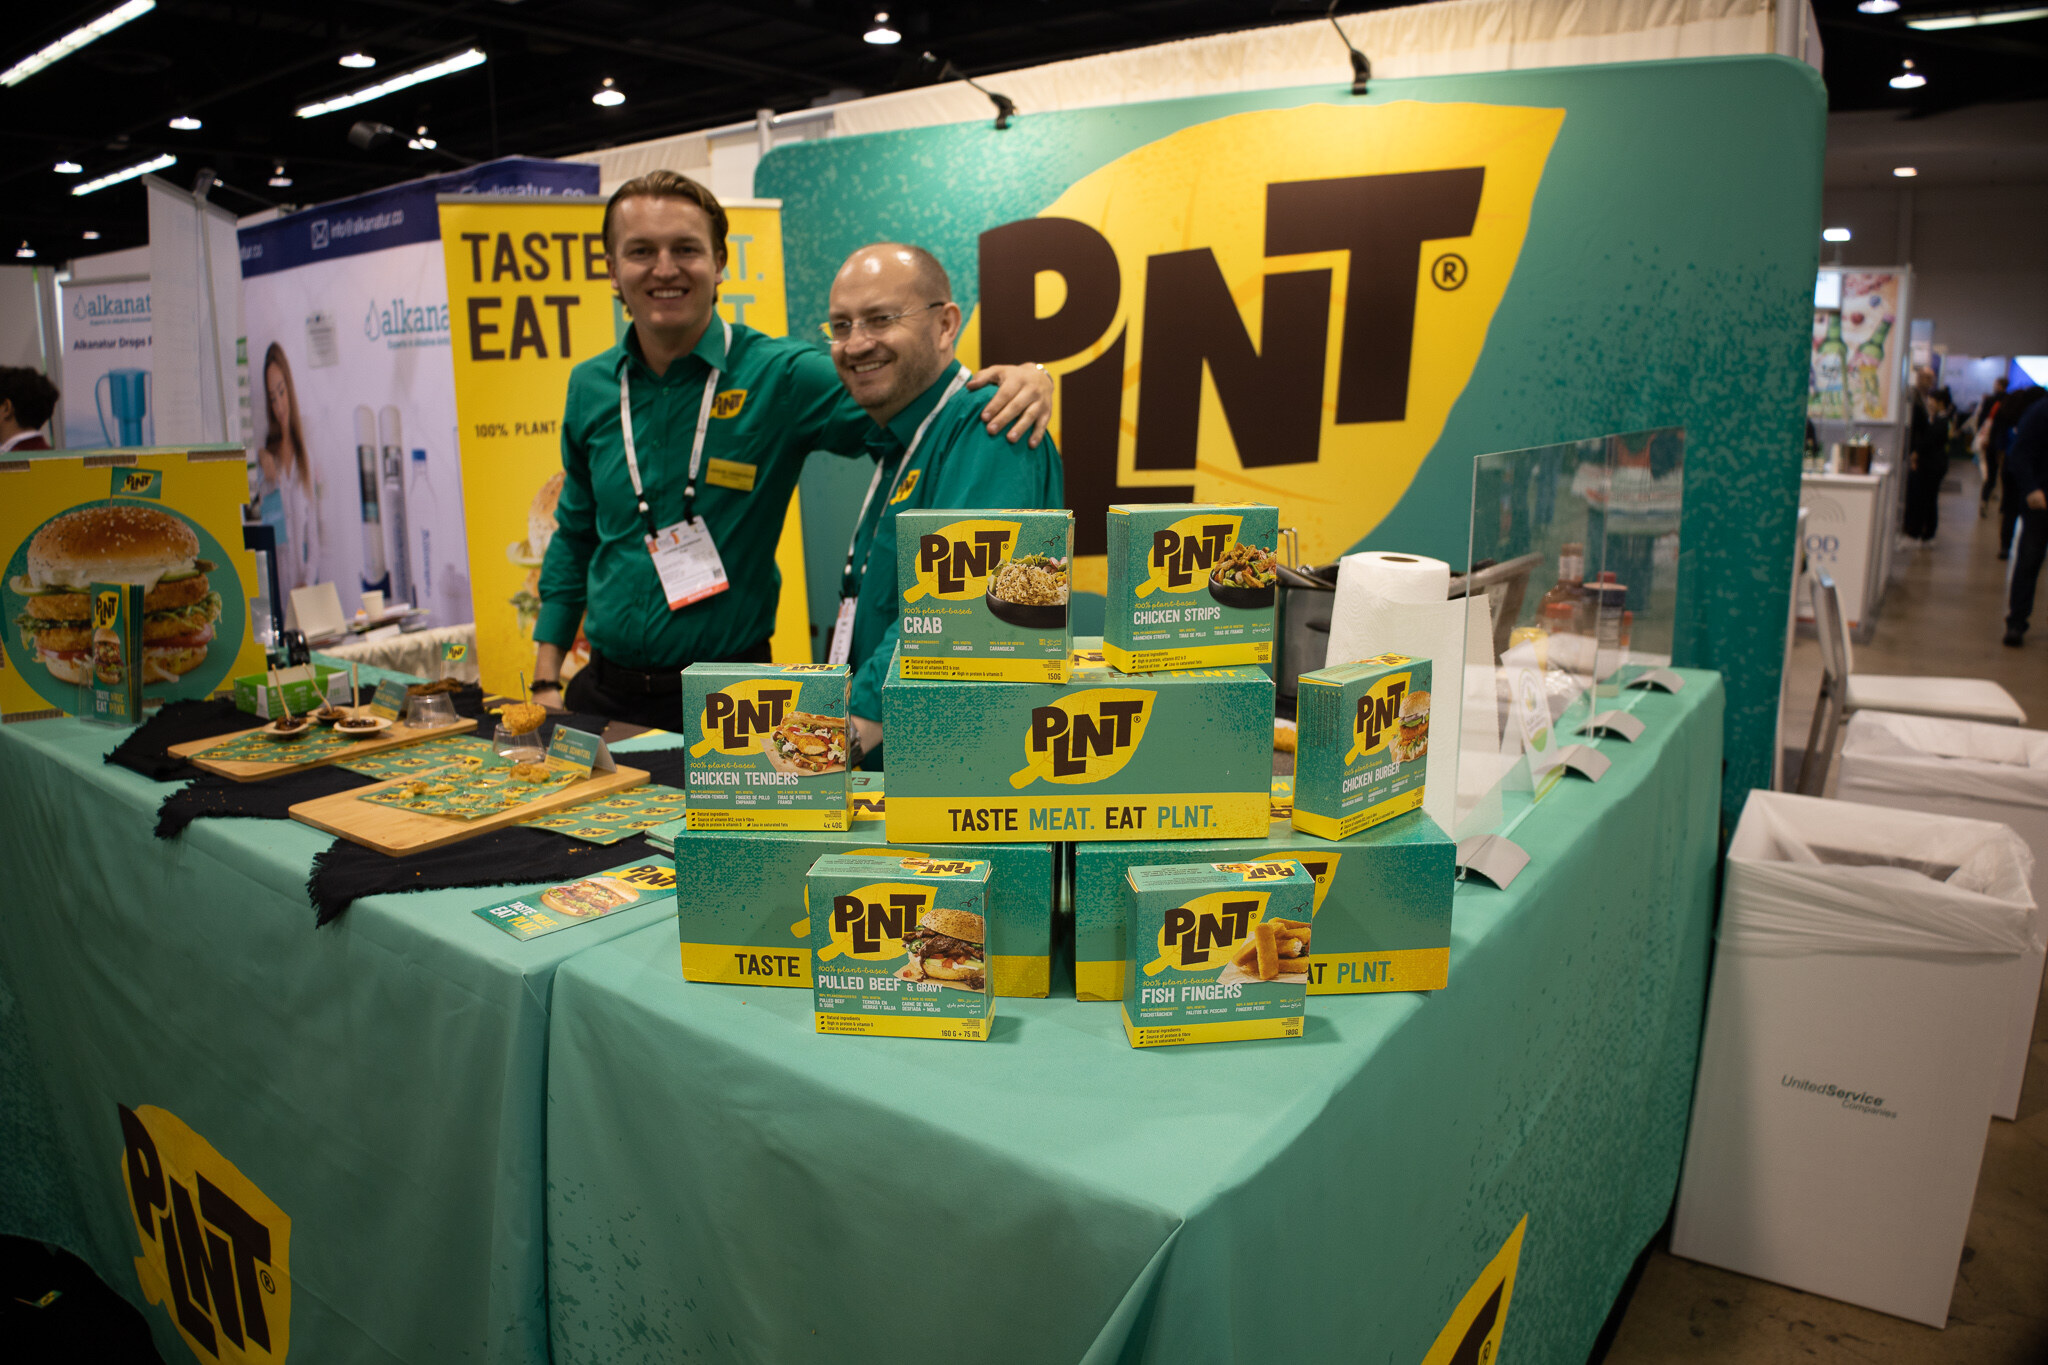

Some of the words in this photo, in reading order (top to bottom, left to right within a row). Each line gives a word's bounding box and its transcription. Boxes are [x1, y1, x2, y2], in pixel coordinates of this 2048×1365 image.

[460, 232, 611, 282] TASTE
[467, 296, 580, 362] EAT
[119, 337, 146, 348] Drops
[474, 422, 508, 438] 100%
[126, 474, 152, 490] PLNT
[97, 597, 116, 626] PLNT
[1152, 600, 1197, 610] plant-based
[1134, 609, 1180, 624] CHICKEN
[1184, 607, 1221, 622] STRIPS
[904, 617, 942, 633] CRAB
[708, 762, 756, 770] plant-based
[690, 772, 740, 785] CHICKEN
[745, 772, 799, 785] TENDERS
[1343, 771, 1373, 794] CHICKEN
[1375, 762, 1400, 781] BURGER
[948, 808, 1018, 832] TASTE
[1029, 808, 1095, 831] MEAT.
[1105, 806, 1147, 830] EAT
[1157, 804, 1217, 828] PLNT.
[489, 908, 518, 919] EAT
[508, 901, 537, 916] TASTE
[734, 954, 800, 978] TASTE
[1337, 961, 1395, 984] PLNT.
[818, 975, 864, 990] PULLED
[869, 977, 901, 991] BEEF
[907, 983, 914, 992] &
[916, 983, 943, 992] GRAVY
[1162, 977, 1214, 987] plant-based
[1142, 988, 1175, 1004] FISH
[1181, 983, 1243, 1002] FINGERS
[1781, 1074, 1886, 1106] UnitedService
[1841, 1100, 1897, 1118] Companies
